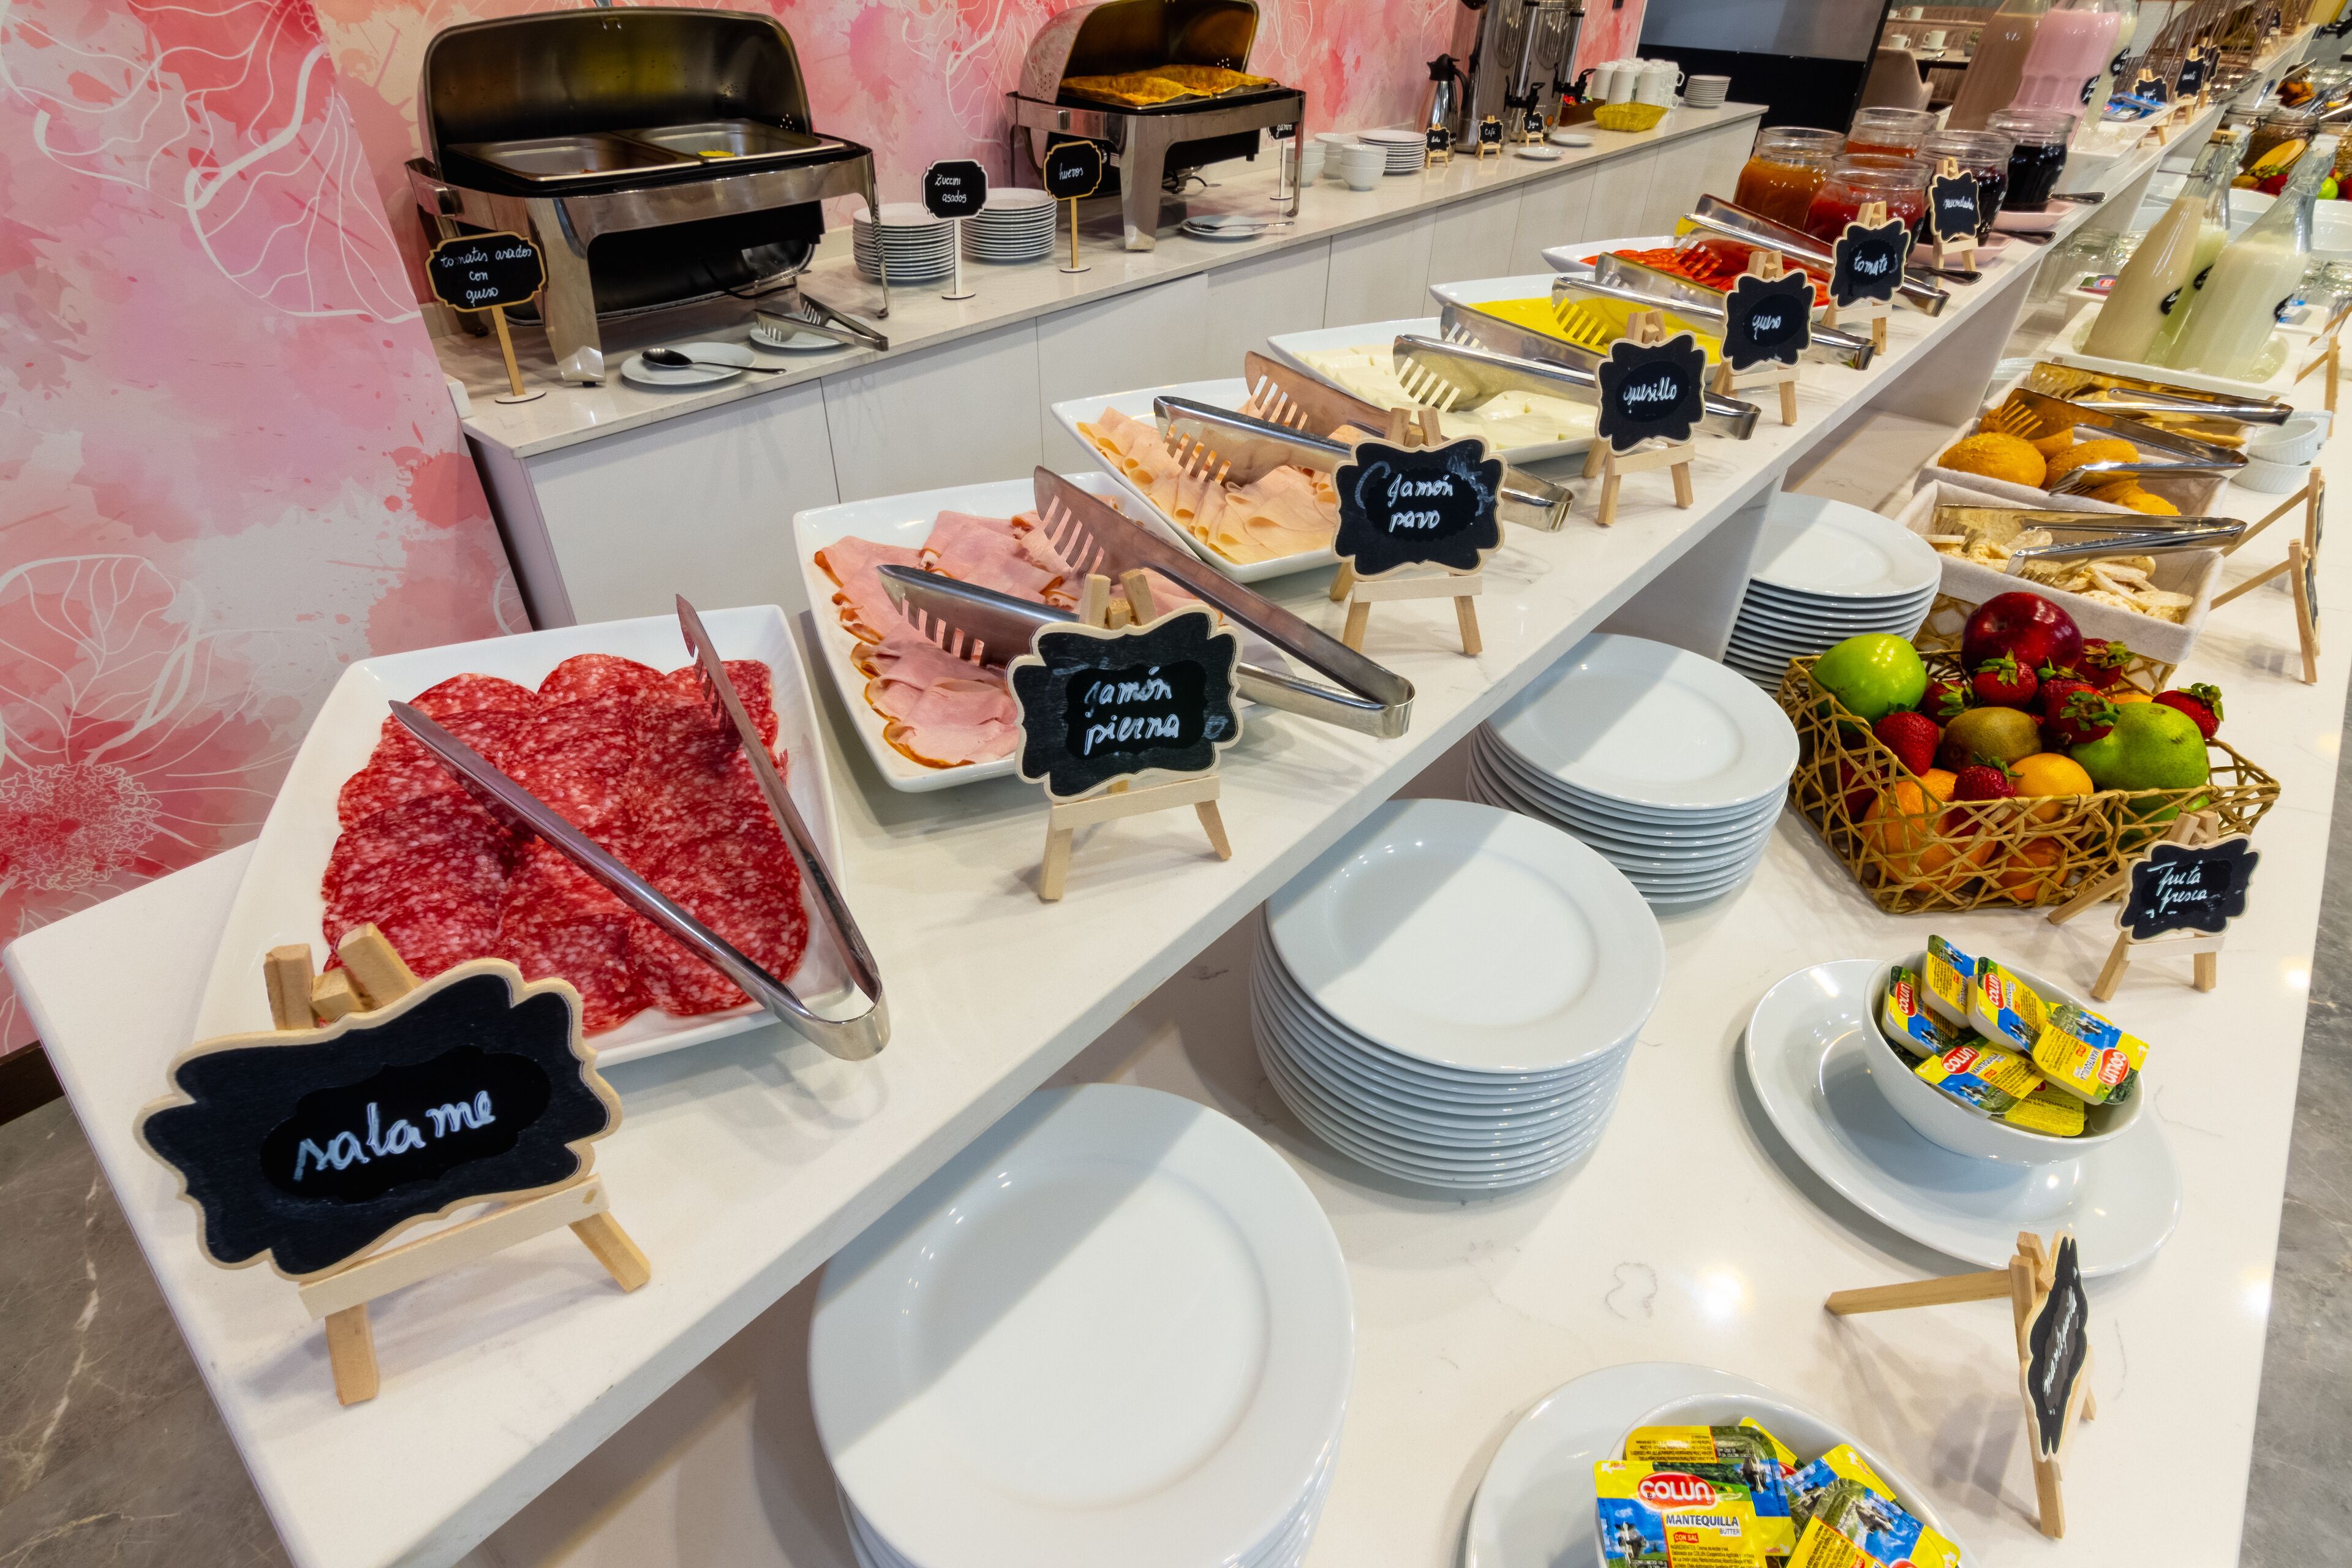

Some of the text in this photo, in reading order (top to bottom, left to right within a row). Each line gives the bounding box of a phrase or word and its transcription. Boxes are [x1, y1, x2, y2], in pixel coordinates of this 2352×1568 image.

[1059, 163, 1084, 181] huevos
[942, 190, 967, 203] asados
[495, 245, 532, 261] asados
[1853, 249, 1887, 276] tomate
[469, 271, 488, 281] con
[466, 287, 498, 307] queso
[1389, 510, 1440, 533] pavo
[1084, 713, 1180, 755] pierna
[2025, 1096, 2075, 1110] ANTEQUILLA
[293, 1090, 496, 1182] salame
[1640, 1480, 1711, 1501] COLUN
[1666, 1514, 1739, 1526] MANTEQUILLA
